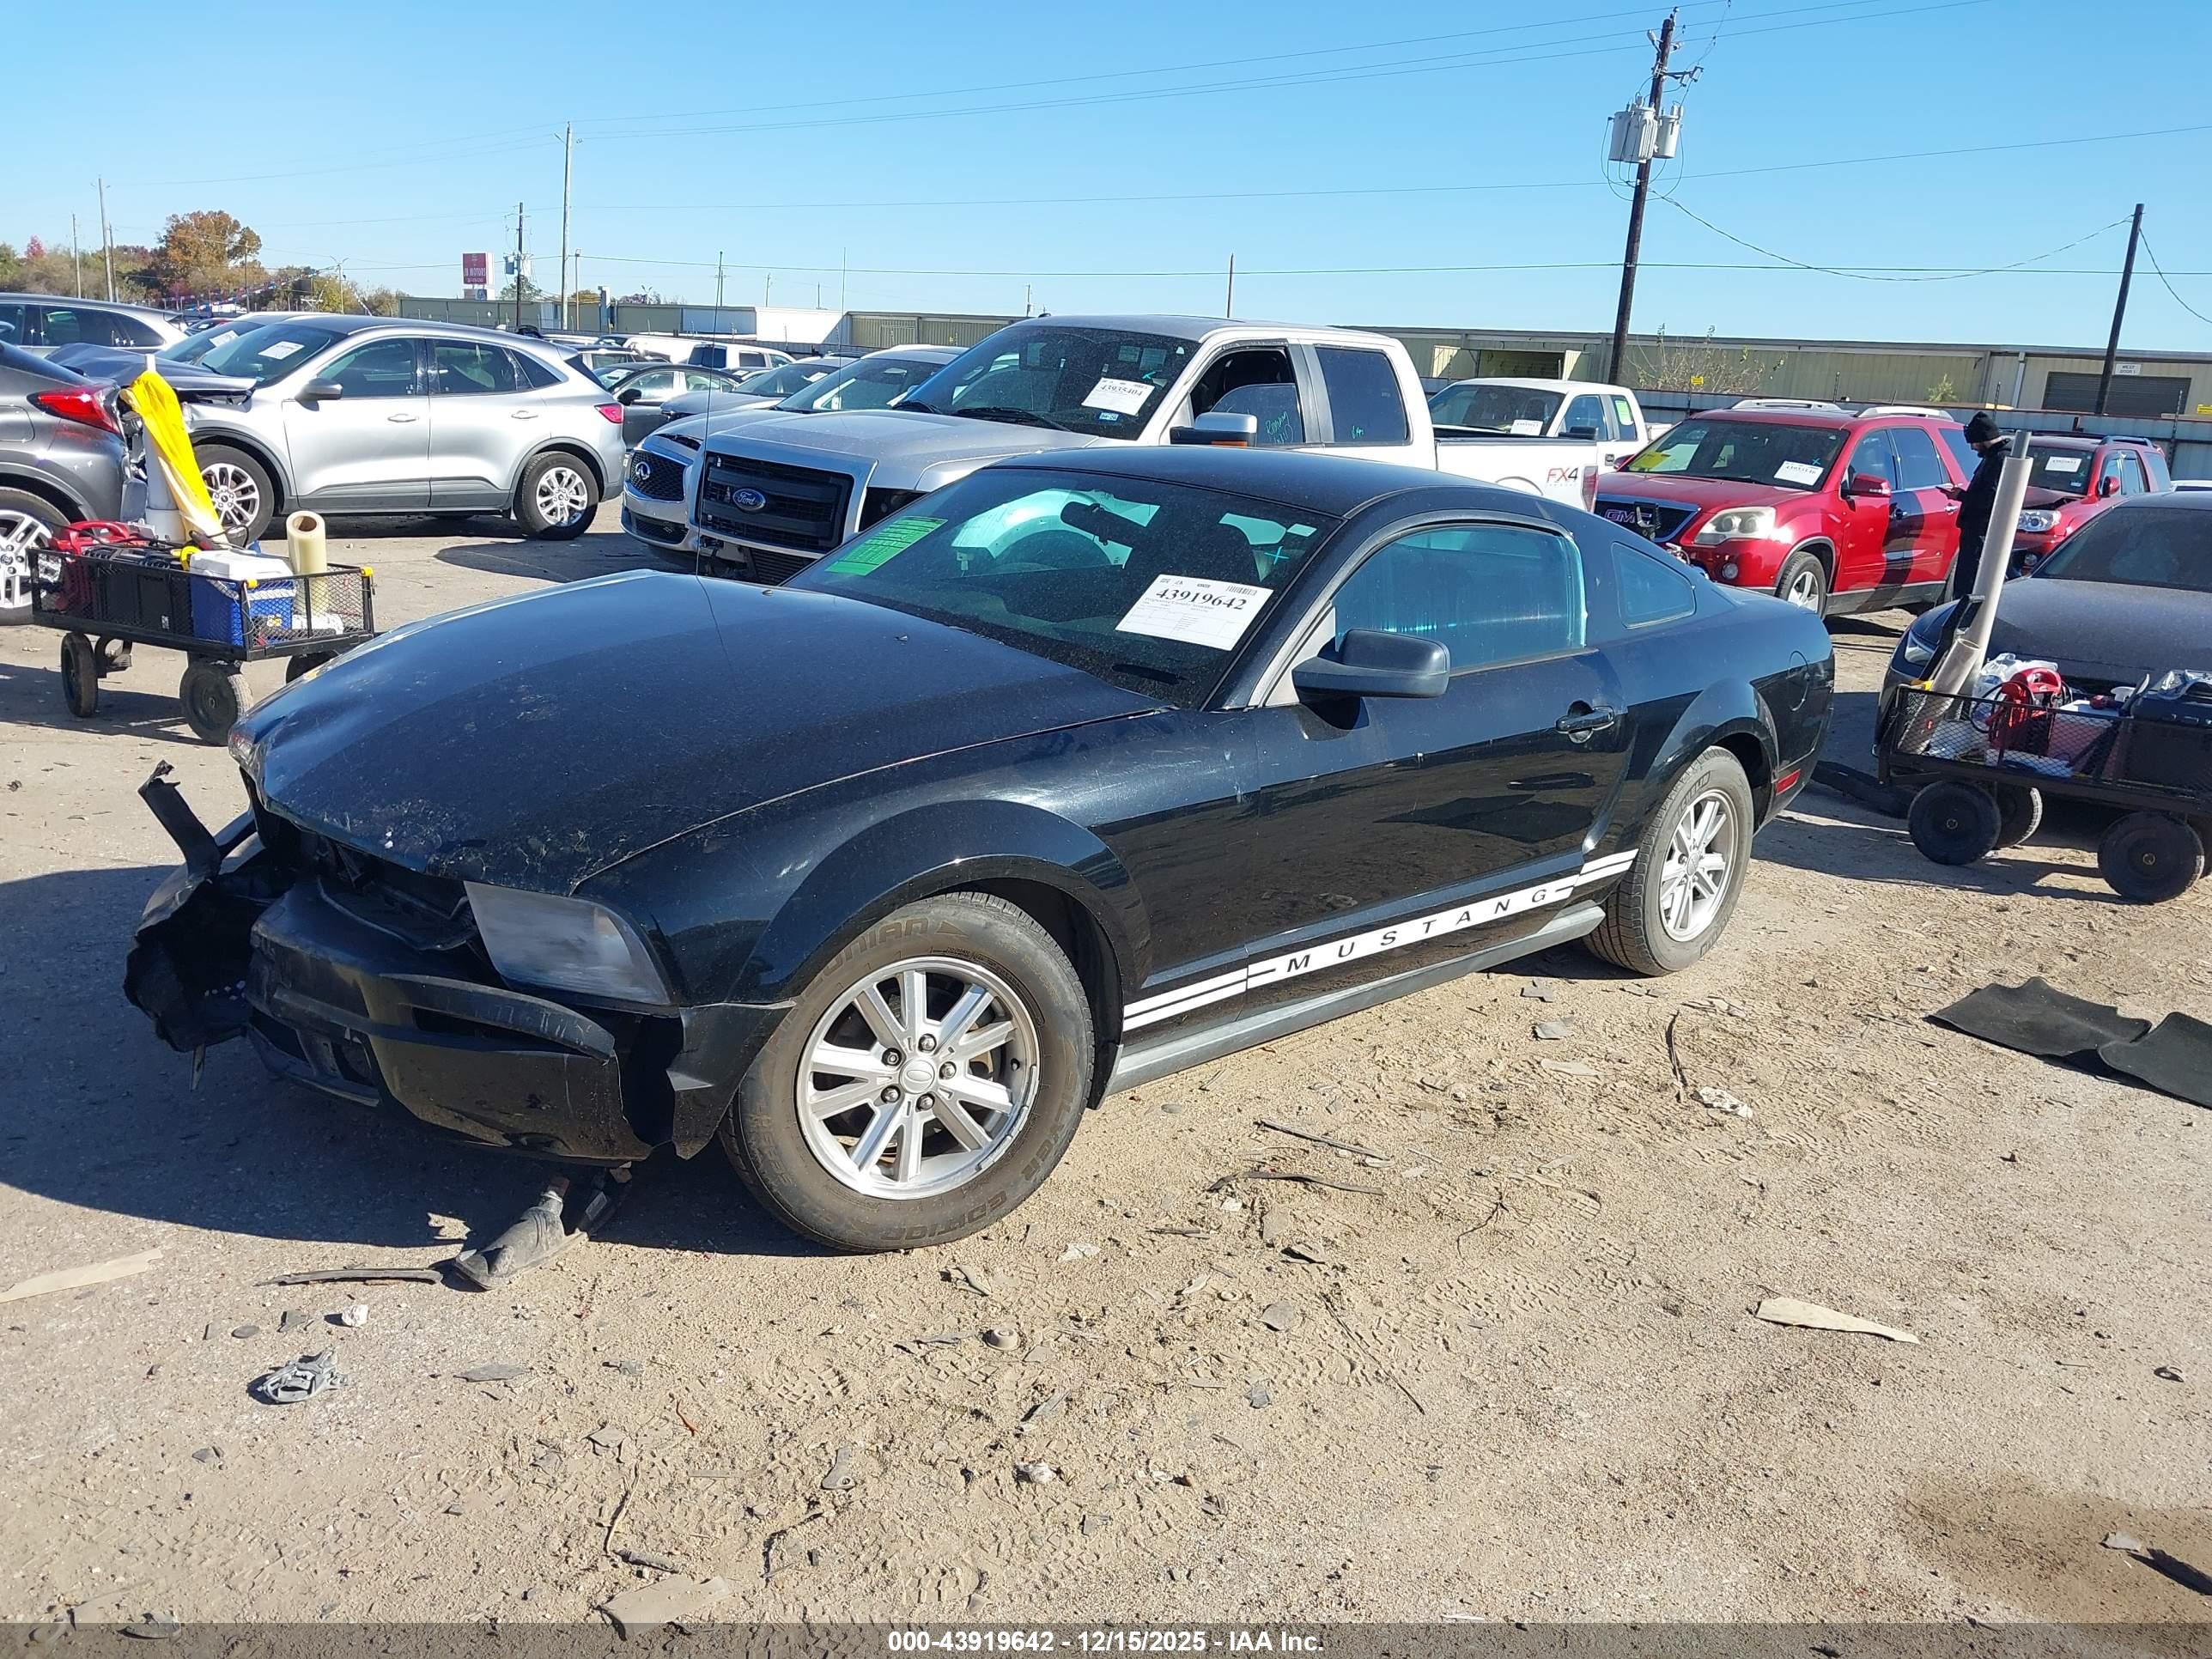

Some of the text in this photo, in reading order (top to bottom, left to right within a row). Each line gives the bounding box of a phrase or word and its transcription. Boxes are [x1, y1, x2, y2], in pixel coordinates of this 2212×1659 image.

[1547, 466, 1579, 483] FX4
[1156, 587, 1247, 611] 43919642
[1286, 889, 1547, 973] MUSTANG
